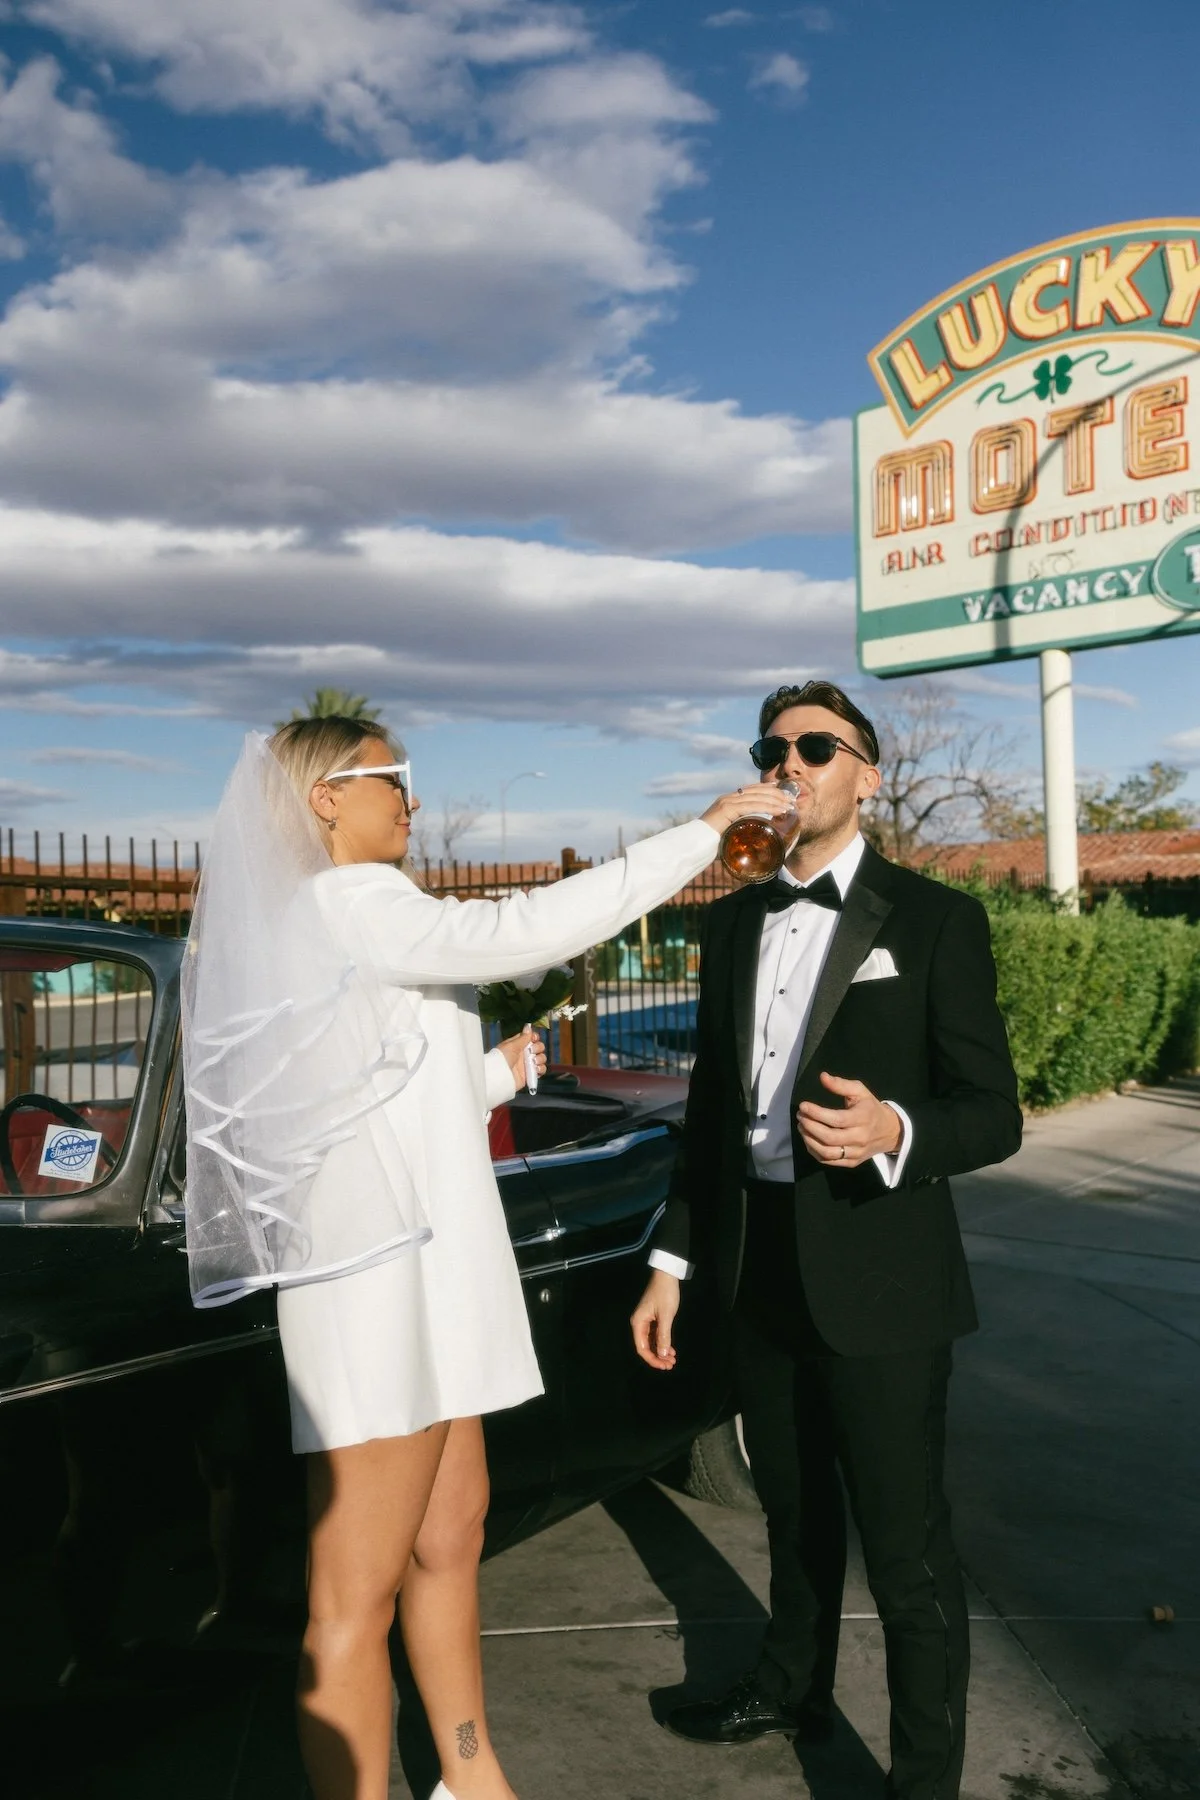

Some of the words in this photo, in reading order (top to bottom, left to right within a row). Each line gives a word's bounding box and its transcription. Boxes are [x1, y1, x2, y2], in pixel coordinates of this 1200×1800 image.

[890, 240, 1200, 410] LUCKY
[873, 377, 1189, 538] MOTE
[963, 565, 1147, 622] VACANCY
[50, 1144, 93, 1159] Studebaker
